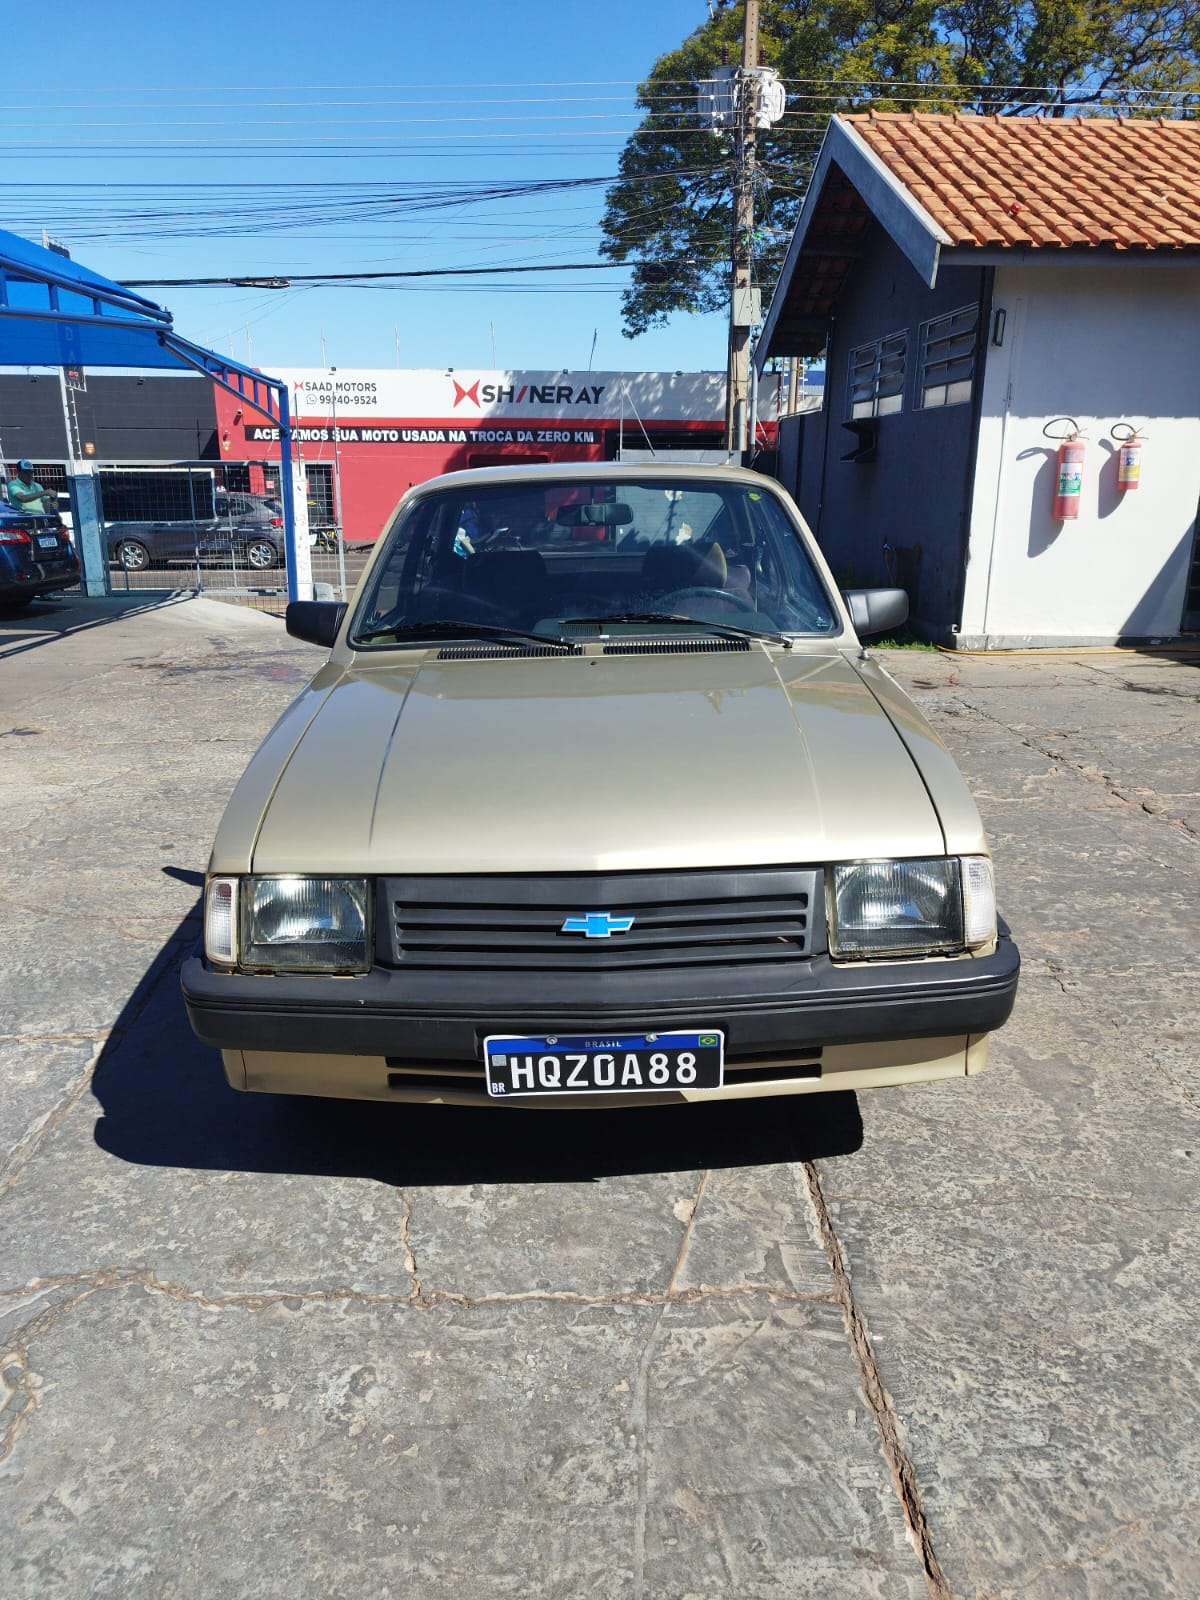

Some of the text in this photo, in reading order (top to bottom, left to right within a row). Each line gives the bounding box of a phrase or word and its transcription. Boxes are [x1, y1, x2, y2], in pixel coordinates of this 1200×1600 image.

[305, 382, 377, 392] SAAD MOTORS
[482, 384, 604, 404] SHINERAY
[254, 428, 594, 443] ACEAMOS SUA MOTO USADA NA TROCA DA ZERO KM
[492, 1082, 506, 1094] BR
